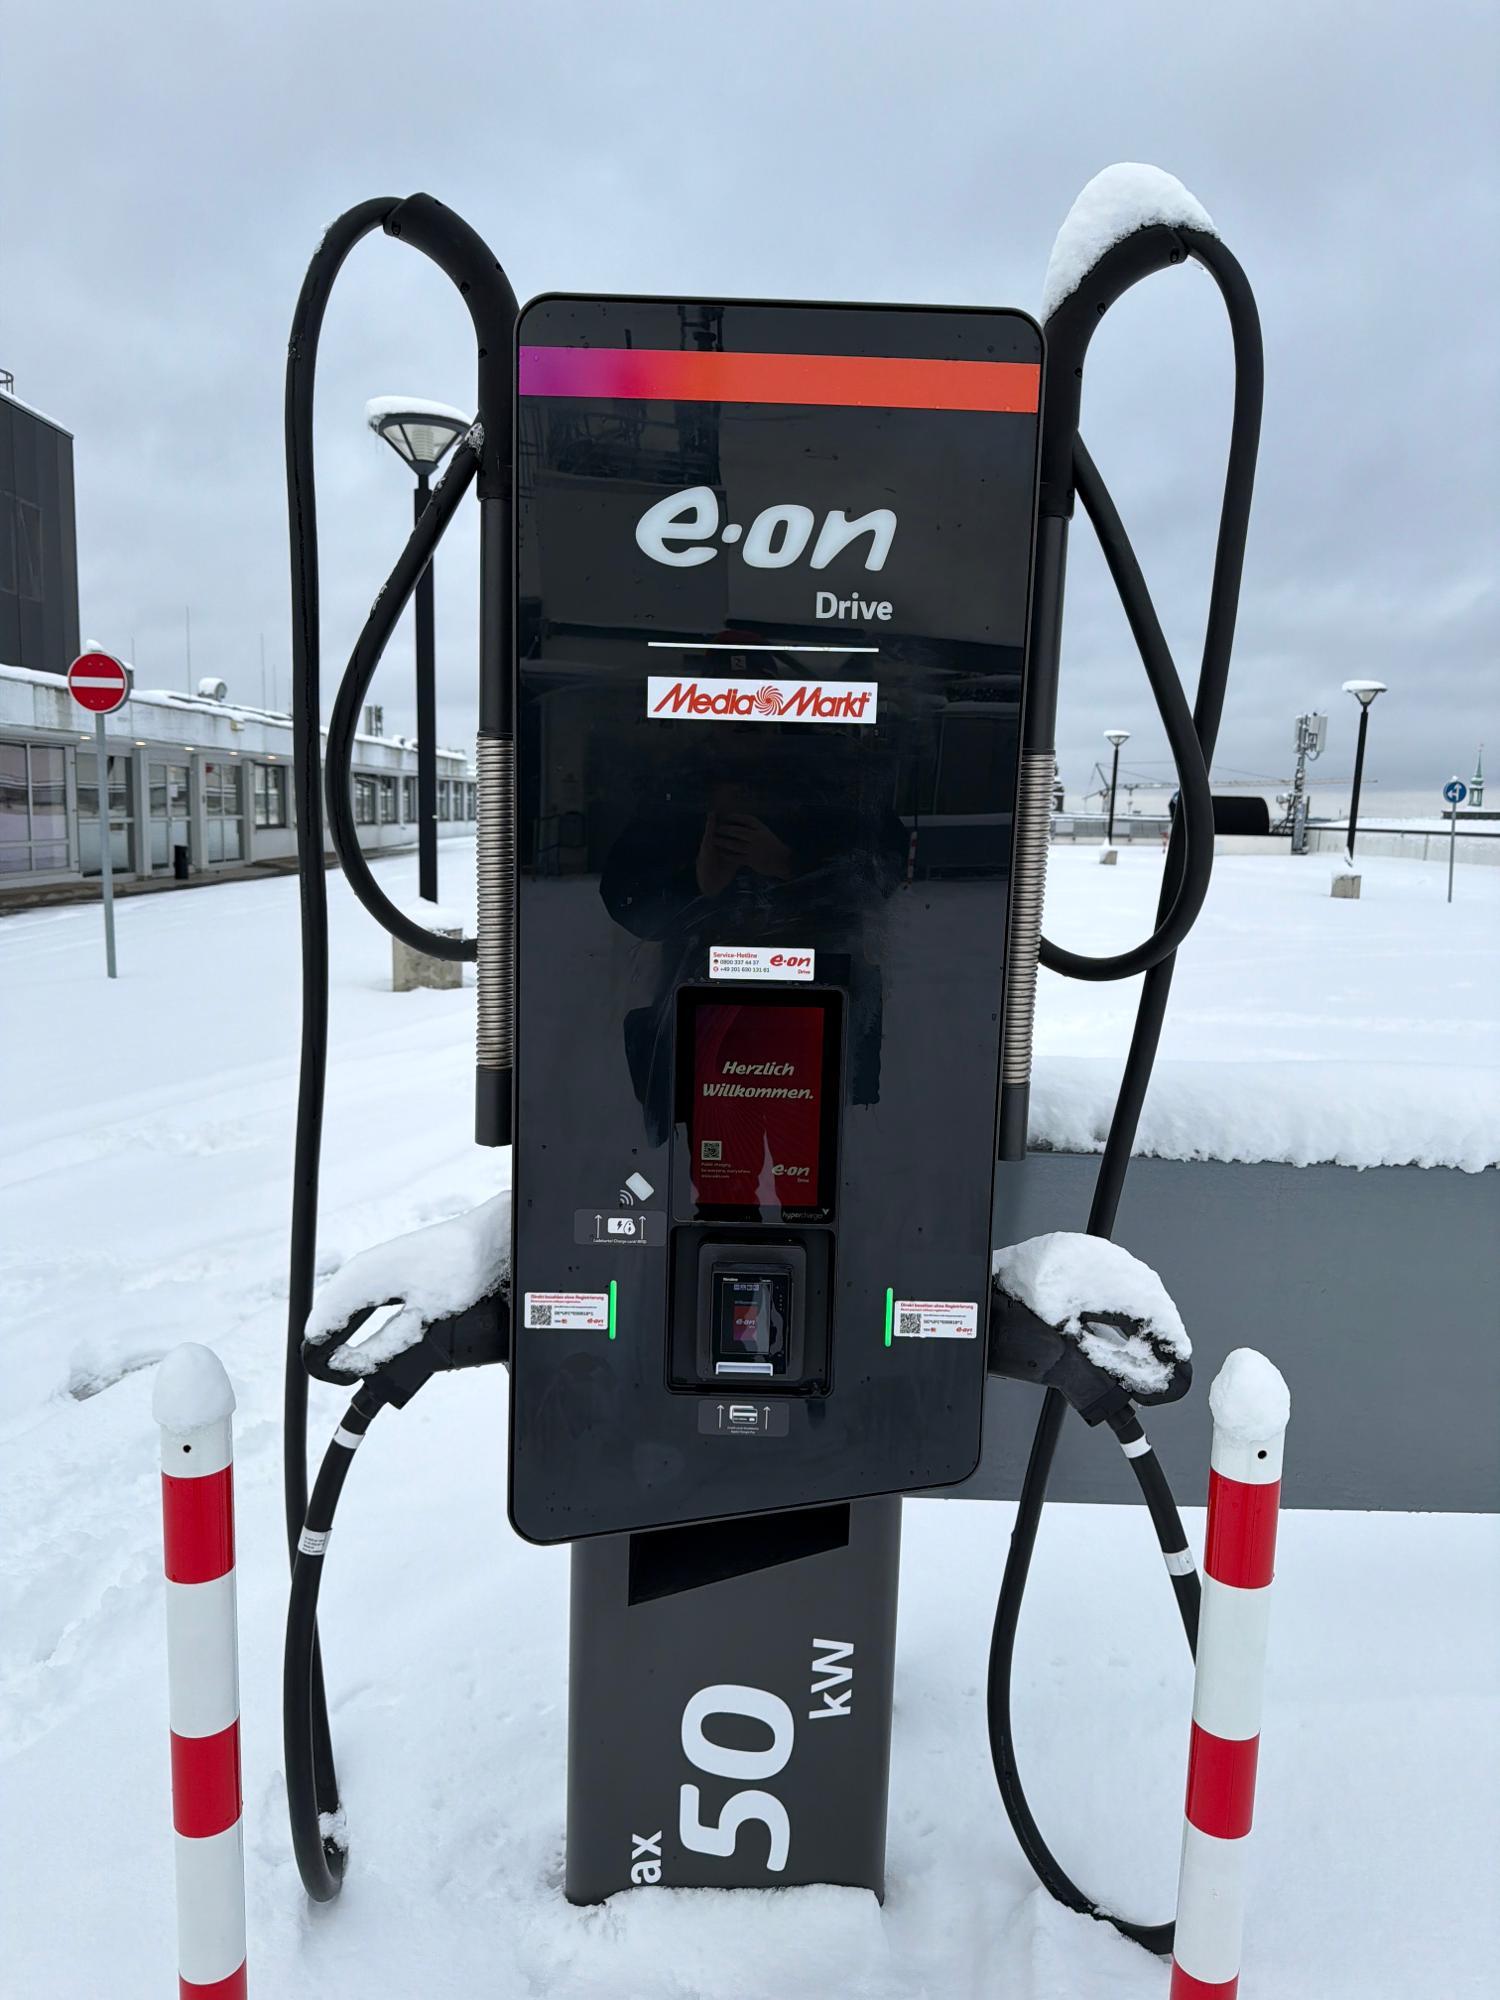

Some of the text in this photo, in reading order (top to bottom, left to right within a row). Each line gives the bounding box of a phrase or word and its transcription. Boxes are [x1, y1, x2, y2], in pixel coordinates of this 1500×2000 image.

[815, 591, 893, 621] Drive
[722, 1061, 795, 1076] Herzlich
[702, 1083, 814, 1099] Willkommen.
[808, 1638, 855, 1720] kW
[679, 1684, 795, 1872] 50
[630, 1830, 663, 1886] ax
